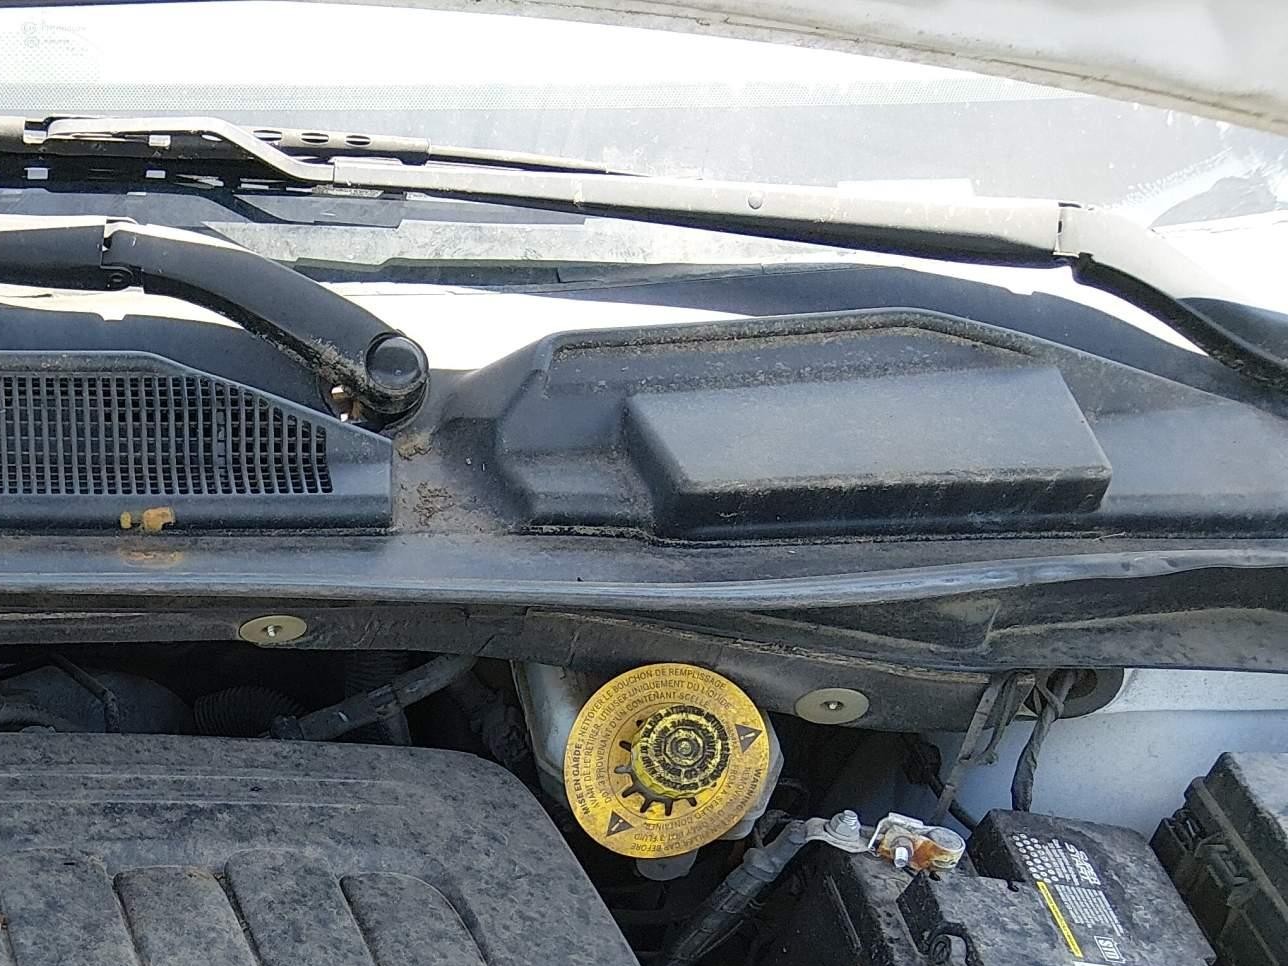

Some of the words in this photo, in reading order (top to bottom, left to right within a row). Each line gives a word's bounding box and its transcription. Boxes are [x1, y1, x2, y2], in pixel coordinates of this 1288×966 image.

[613, 670, 653, 694] BOUCHON
[655, 668, 667, 677] DE
[669, 668, 727, 690] REMPLISSAGE
[600, 696, 627, 721] UTILISER
[628, 679, 685, 699] UNIQUEMENT
[687, 681, 701, 692] DU
[601, 689, 614, 702] LE
[625, 690, 677, 713] CONTENANT
[578, 697, 606, 738] NETTOYER
[573, 775, 582, 790] EN
[575, 791, 591, 815] MISE
[694, 795, 722, 820] SEALED
[630, 842, 660, 852] BEFORE
[1063, 841, 1091, 884] START
[1077, 850, 1101, 885] SUPER
